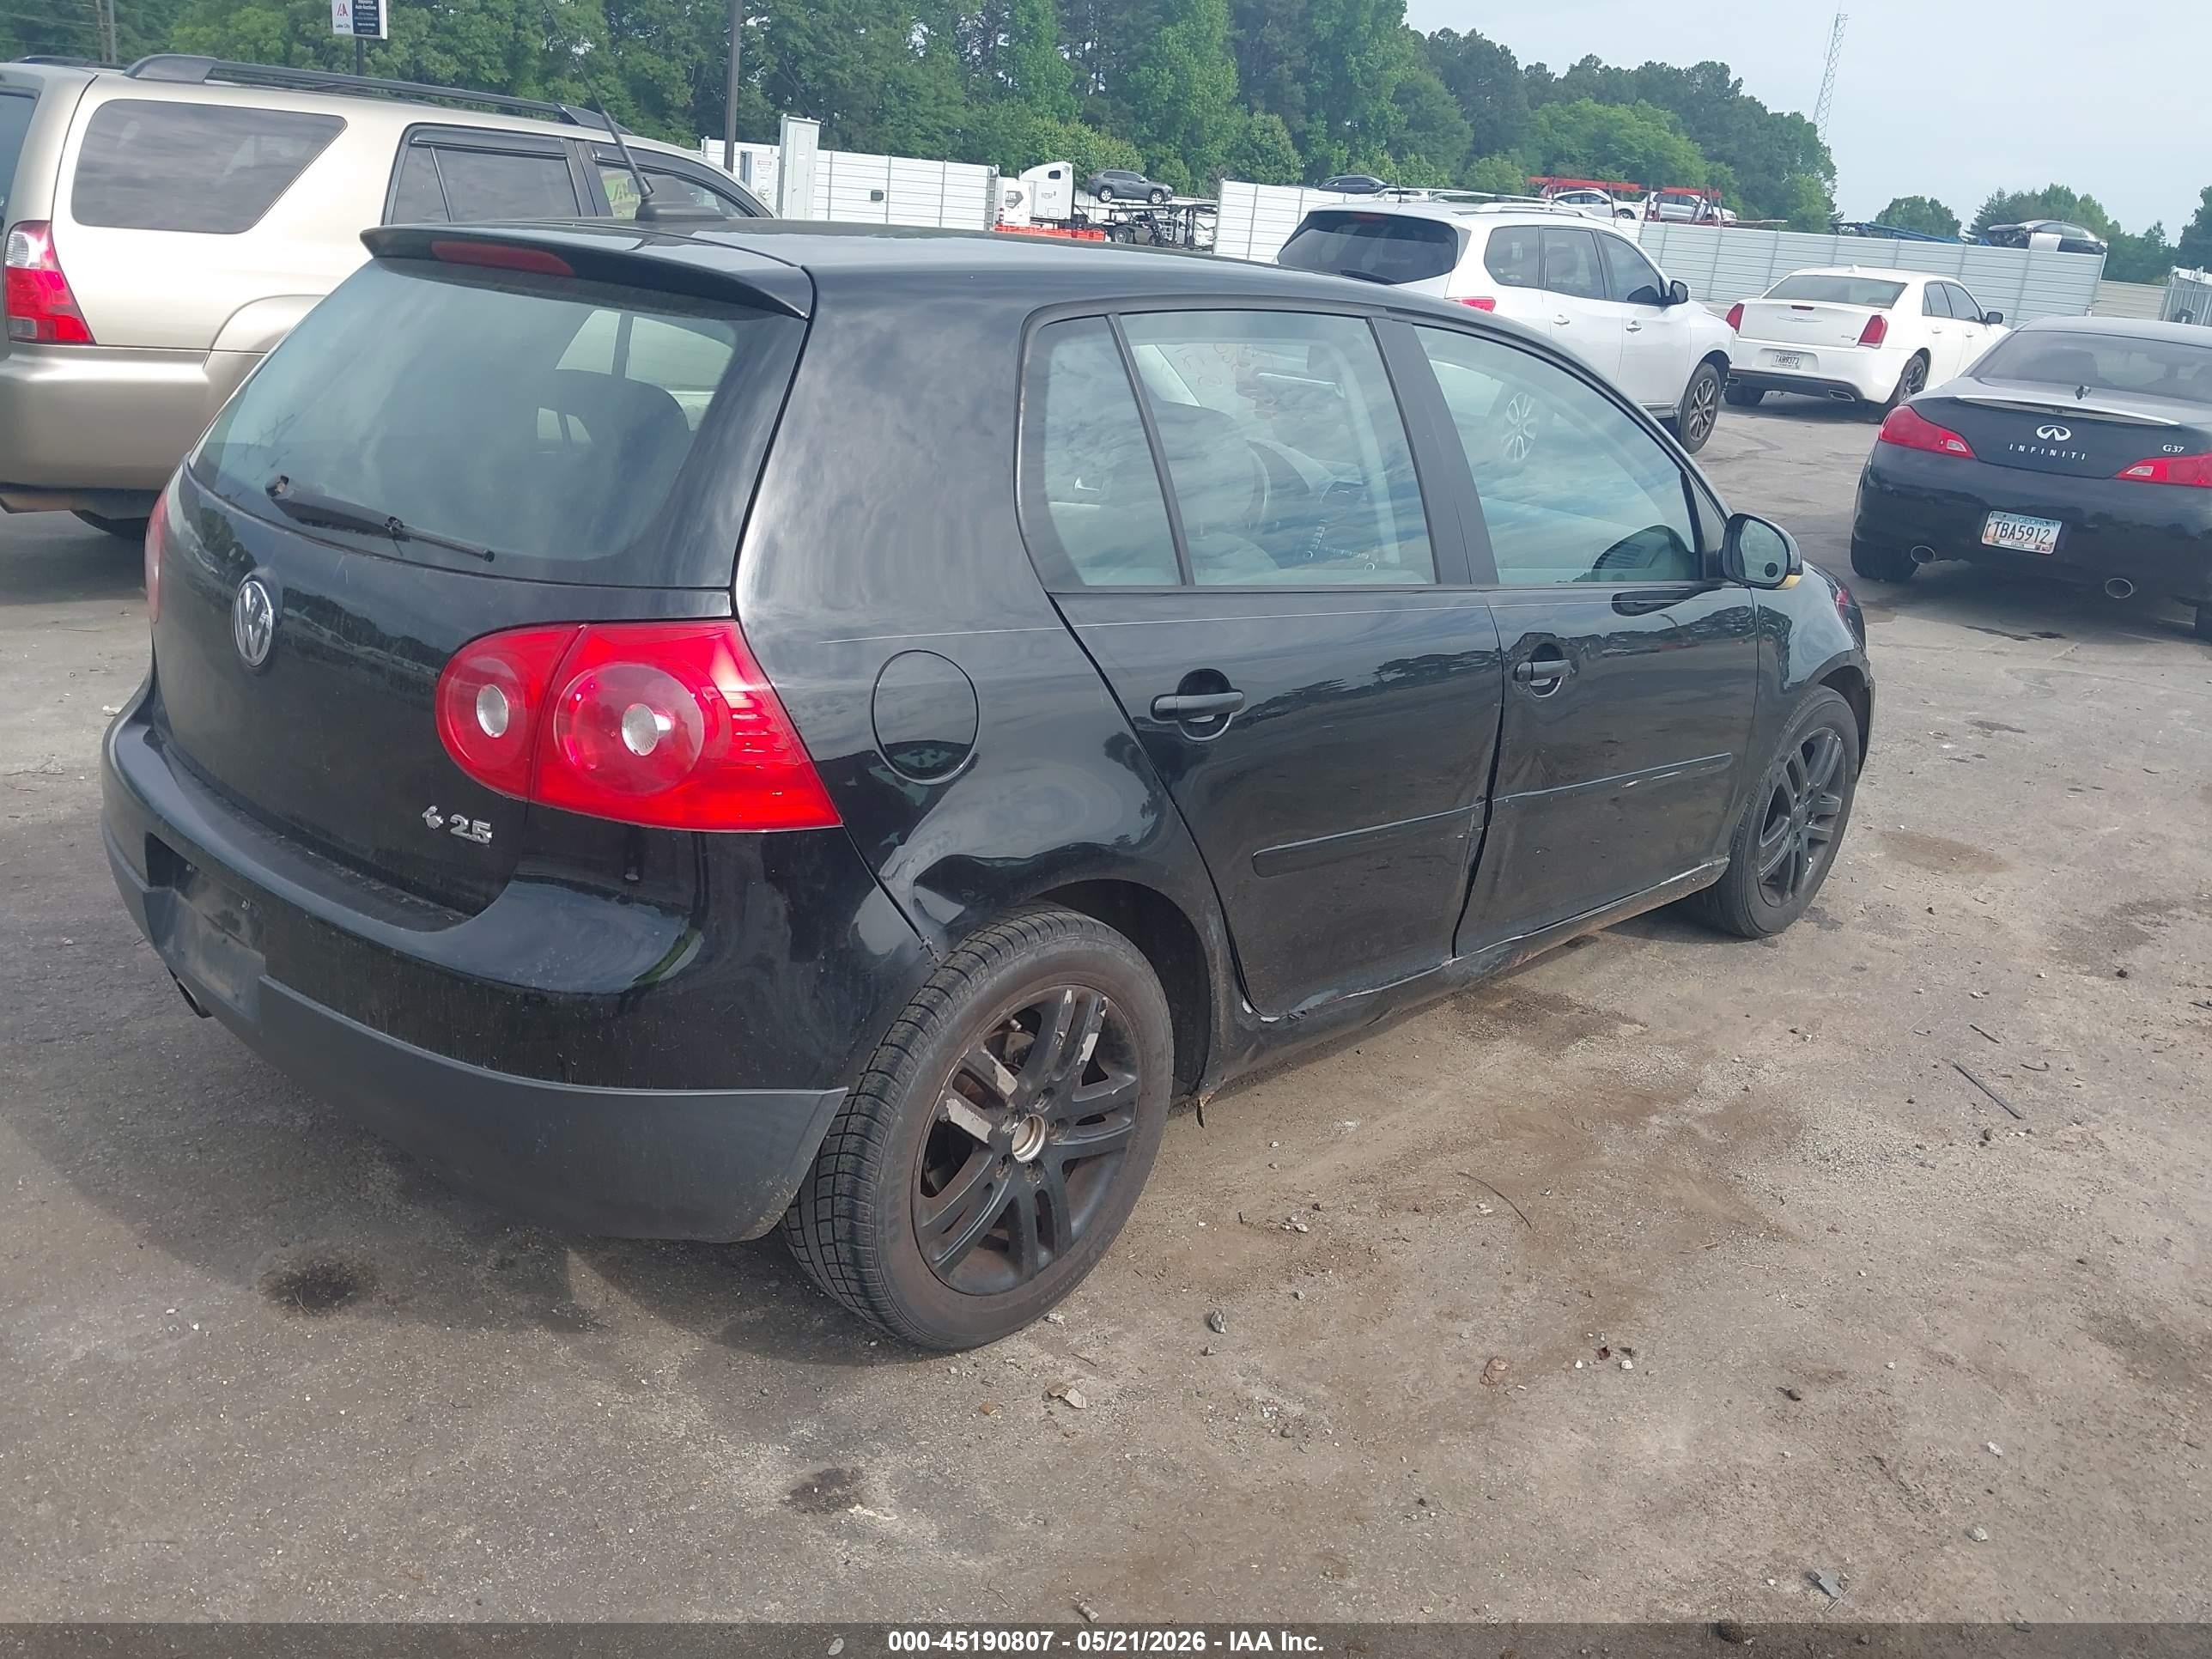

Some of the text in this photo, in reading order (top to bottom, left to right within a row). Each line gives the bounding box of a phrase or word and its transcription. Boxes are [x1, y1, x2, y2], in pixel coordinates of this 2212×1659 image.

[2009, 443, 2087, 461] INFINITI
[2162, 444, 2185, 453] G37
[1993, 520, 2051, 544] TBA5912
